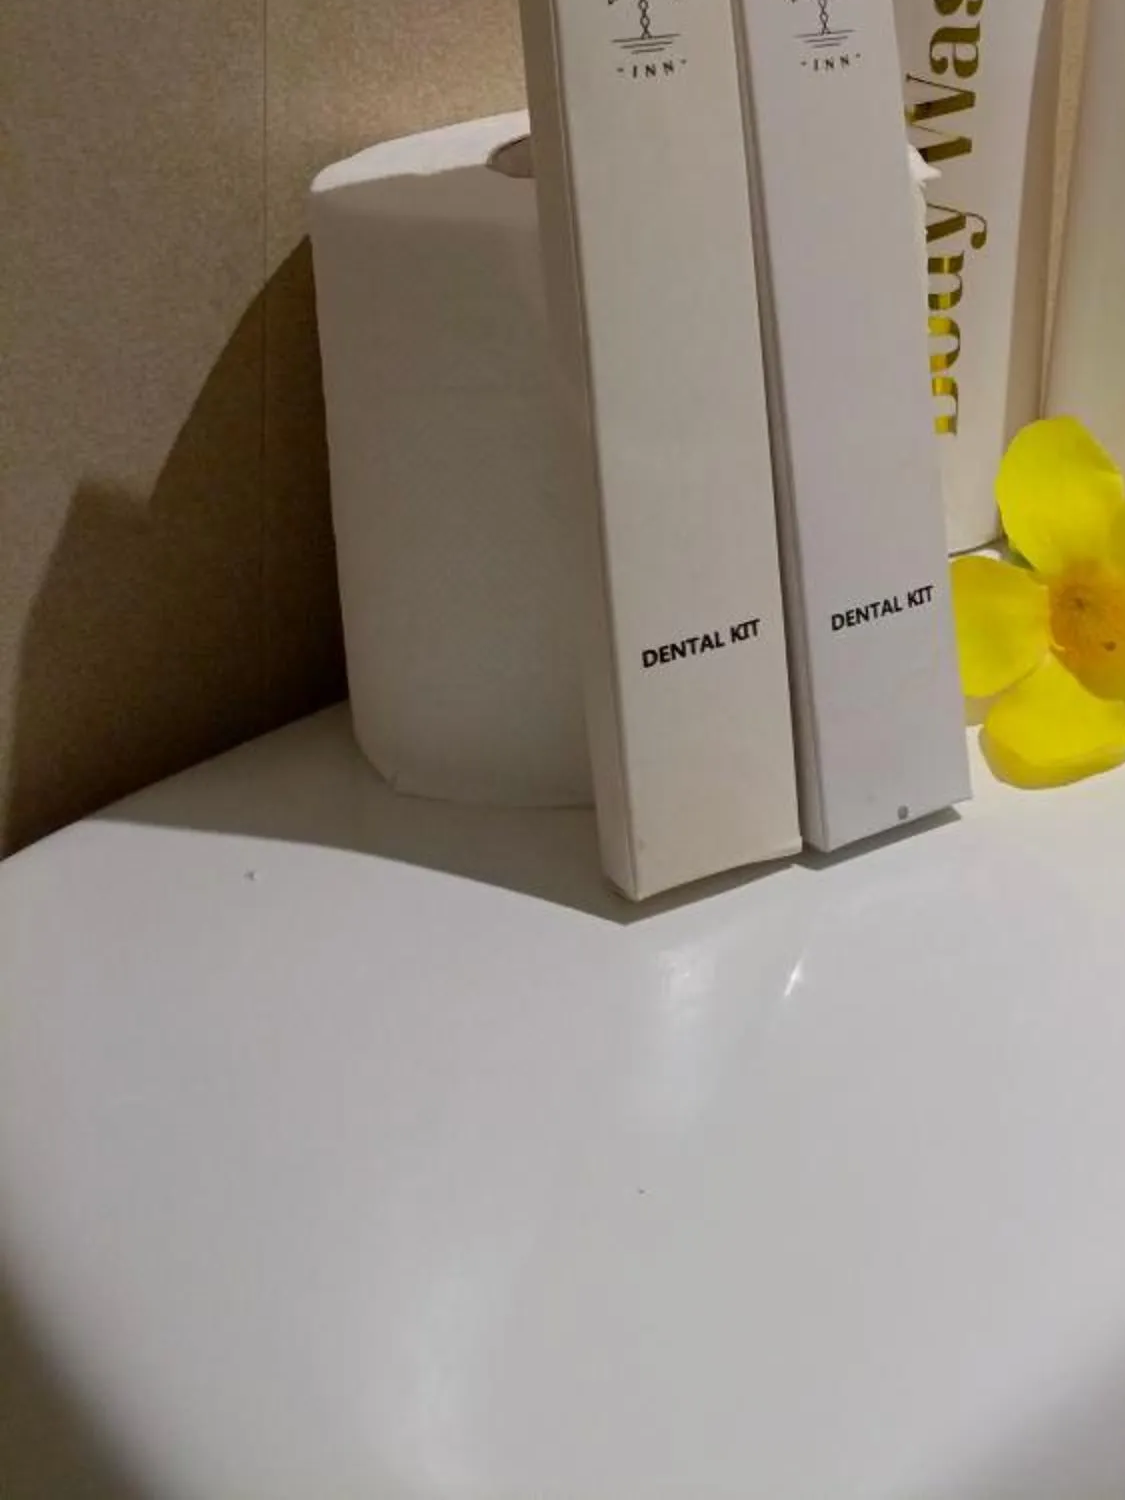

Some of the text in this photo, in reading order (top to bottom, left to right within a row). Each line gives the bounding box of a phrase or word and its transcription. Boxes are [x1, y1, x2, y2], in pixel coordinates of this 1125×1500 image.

[633, 61, 675, 78] INN
[814, 55, 850, 71] INN
[831, 585, 934, 631] DENTAL KIT
[641, 618, 760, 668] DENTAL KIT
